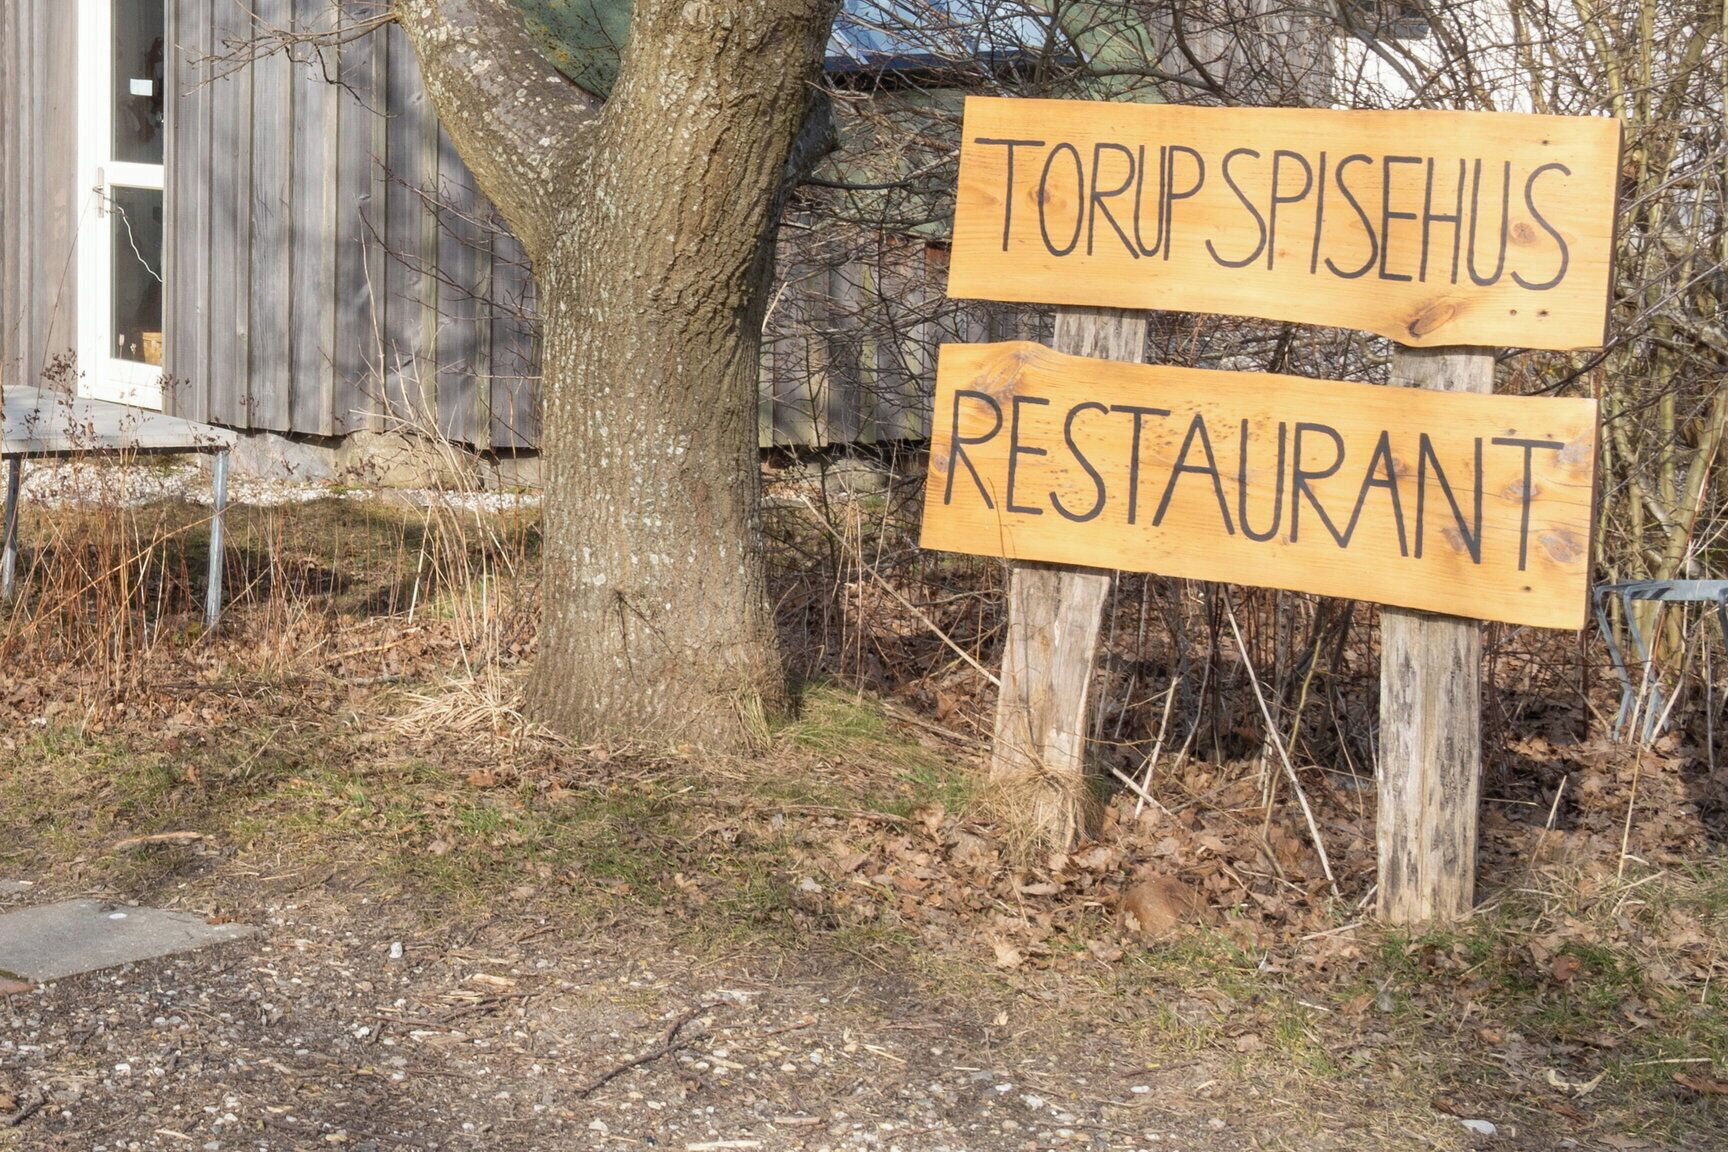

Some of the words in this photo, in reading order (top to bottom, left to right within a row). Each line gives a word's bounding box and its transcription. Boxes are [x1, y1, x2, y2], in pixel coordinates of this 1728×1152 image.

[974, 137, 1205, 262] TORUP
[1205, 147, 1572, 290] SPISEHUS
[943, 389, 1566, 572] RESTAURANT
